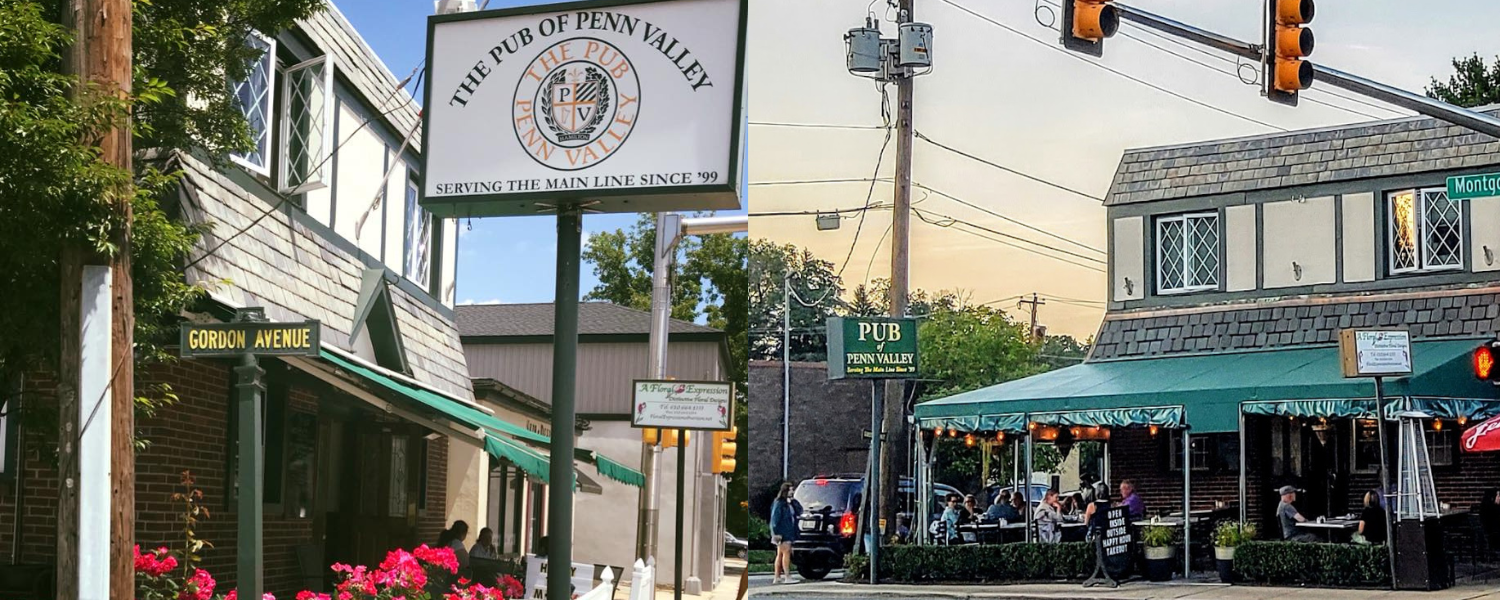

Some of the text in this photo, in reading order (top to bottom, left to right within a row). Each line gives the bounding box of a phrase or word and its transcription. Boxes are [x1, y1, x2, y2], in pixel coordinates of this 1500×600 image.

[449, 11, 714, 110] THE PUB OF PENN VALLEY
[525, 41, 629, 82] THE PUB
[560, 87, 571, 102] P
[577, 107, 591, 121] V
[516, 93, 637, 166] PENN VALLEY
[559, 133, 589, 141] HAMILTON
[436, 170, 719, 195] SERVING THE MAIN LINE SINCE '99
[189, 328, 310, 349] GORDON AVENUE
[858, 322, 901, 342] PUB
[876, 341, 886, 352] of
[847, 353, 914, 364] PENN VALLEY
[639, 383, 728, 397] A Floral Expression
[1108, 509, 1122, 519] OPEN
[1107, 526, 1126, 537] OUTSIDE
[1103, 536, 1118, 548] HAPPY
[1106, 544, 1127, 556] TAKEOUT
